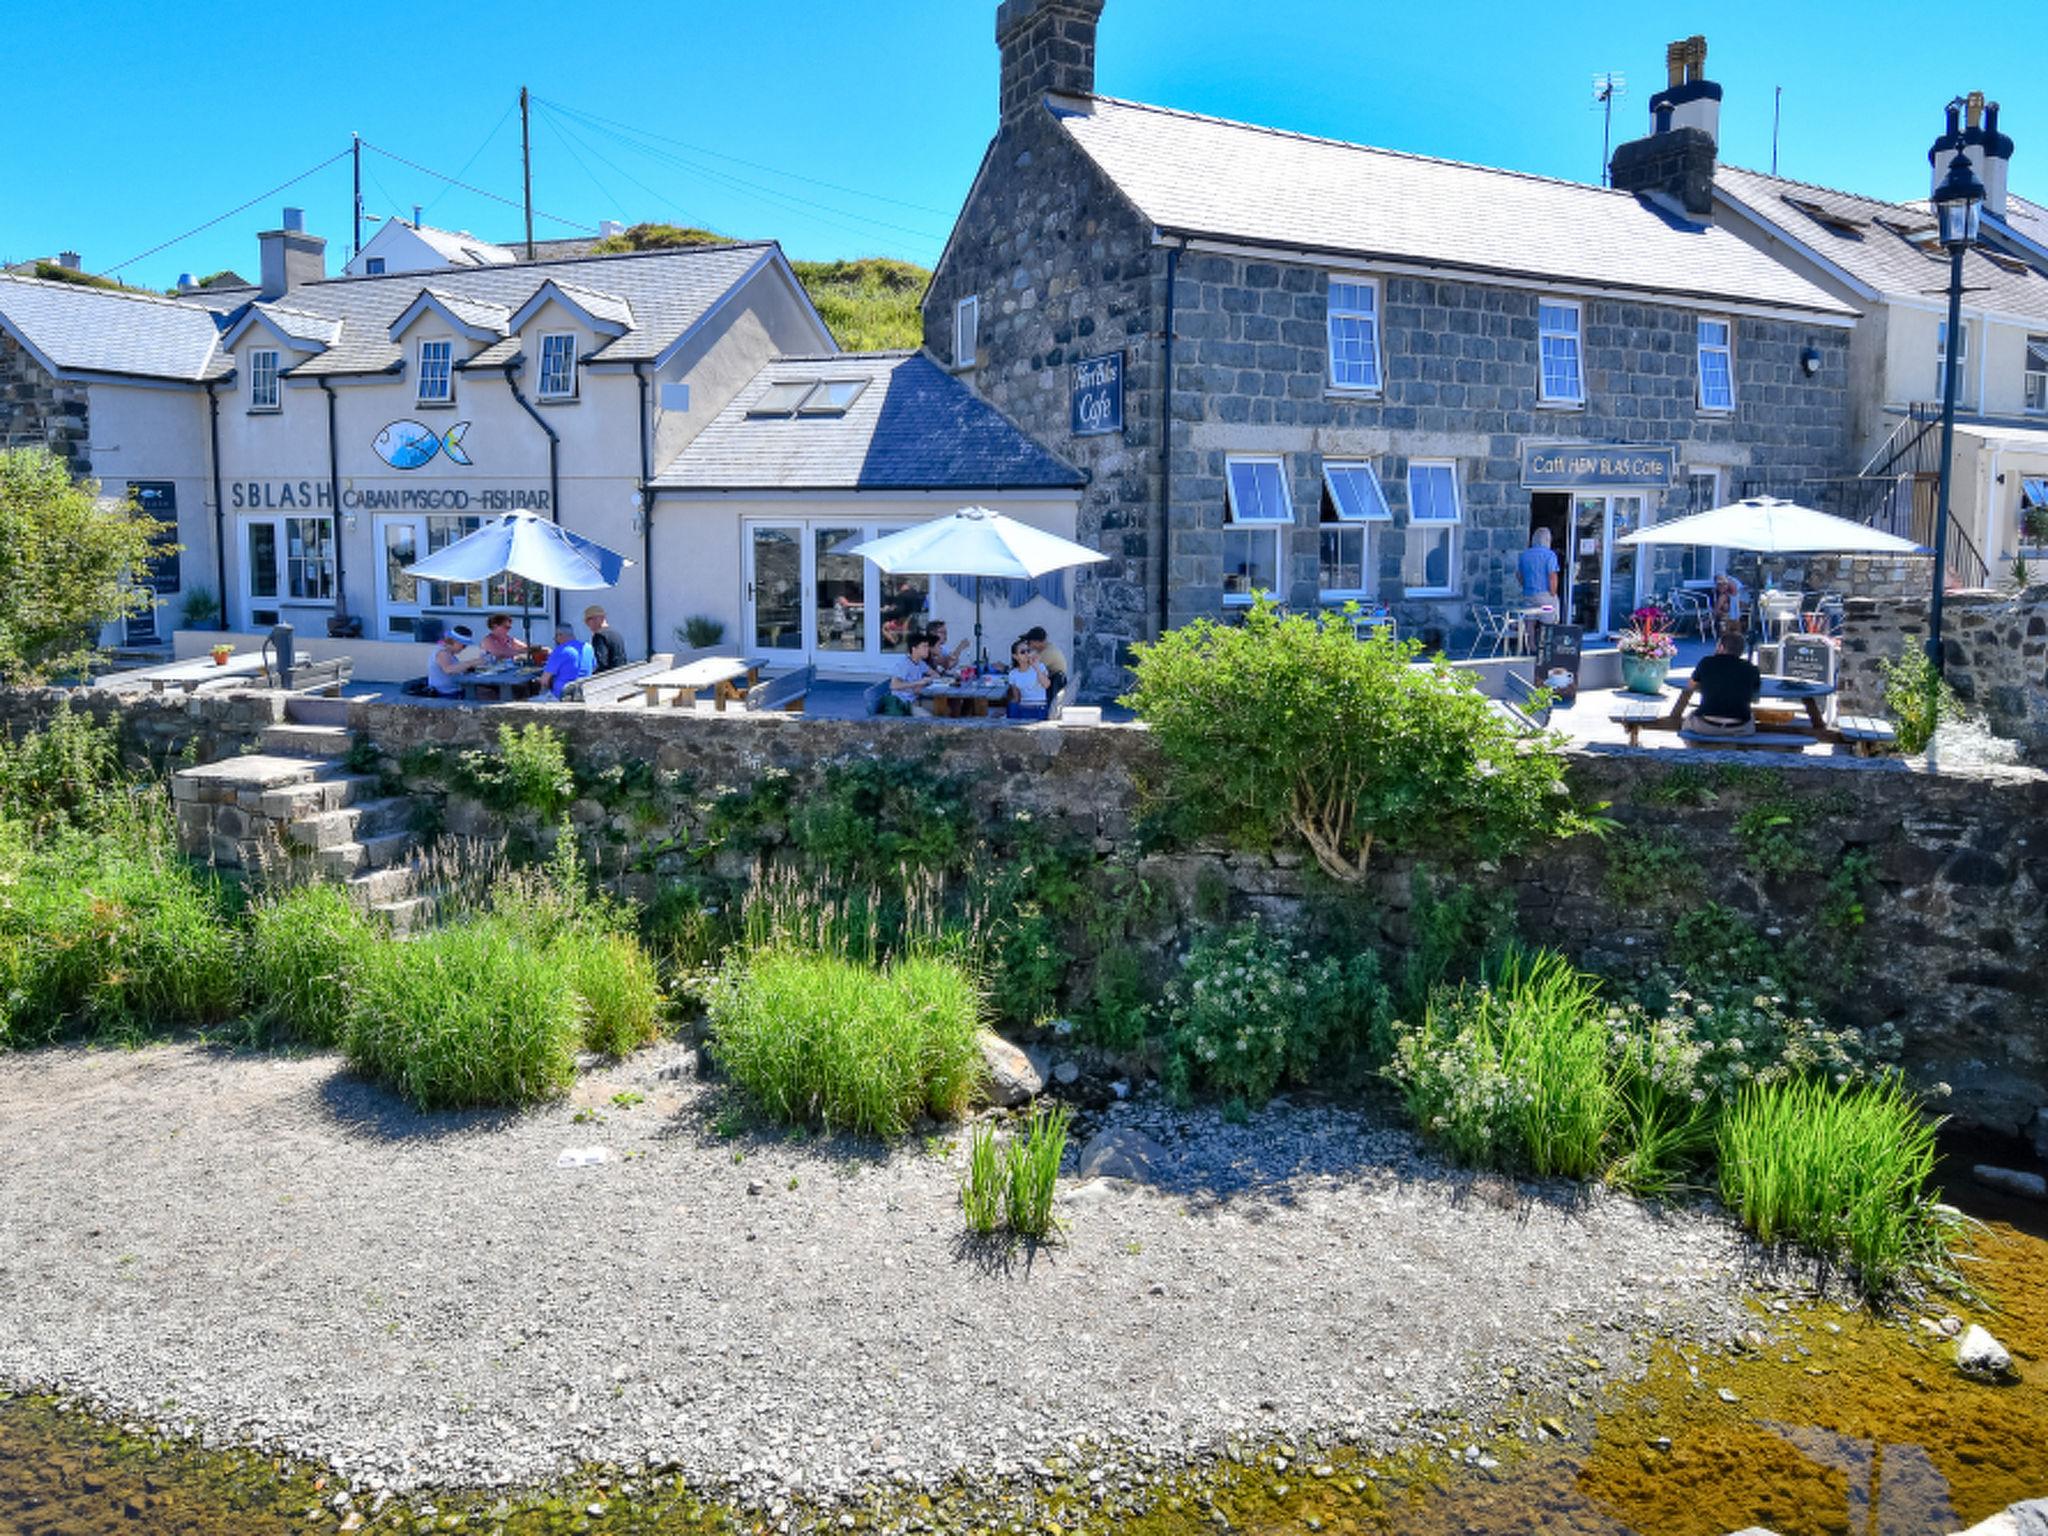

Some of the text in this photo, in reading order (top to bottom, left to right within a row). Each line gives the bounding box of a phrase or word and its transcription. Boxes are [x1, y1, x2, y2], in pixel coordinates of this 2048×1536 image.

[1568, 457, 1597, 475] HEN
[231, 481, 332, 508] SBLASH
[343, 489, 398, 509] CABAN
[401, 489, 468, 510] PYSGOD
